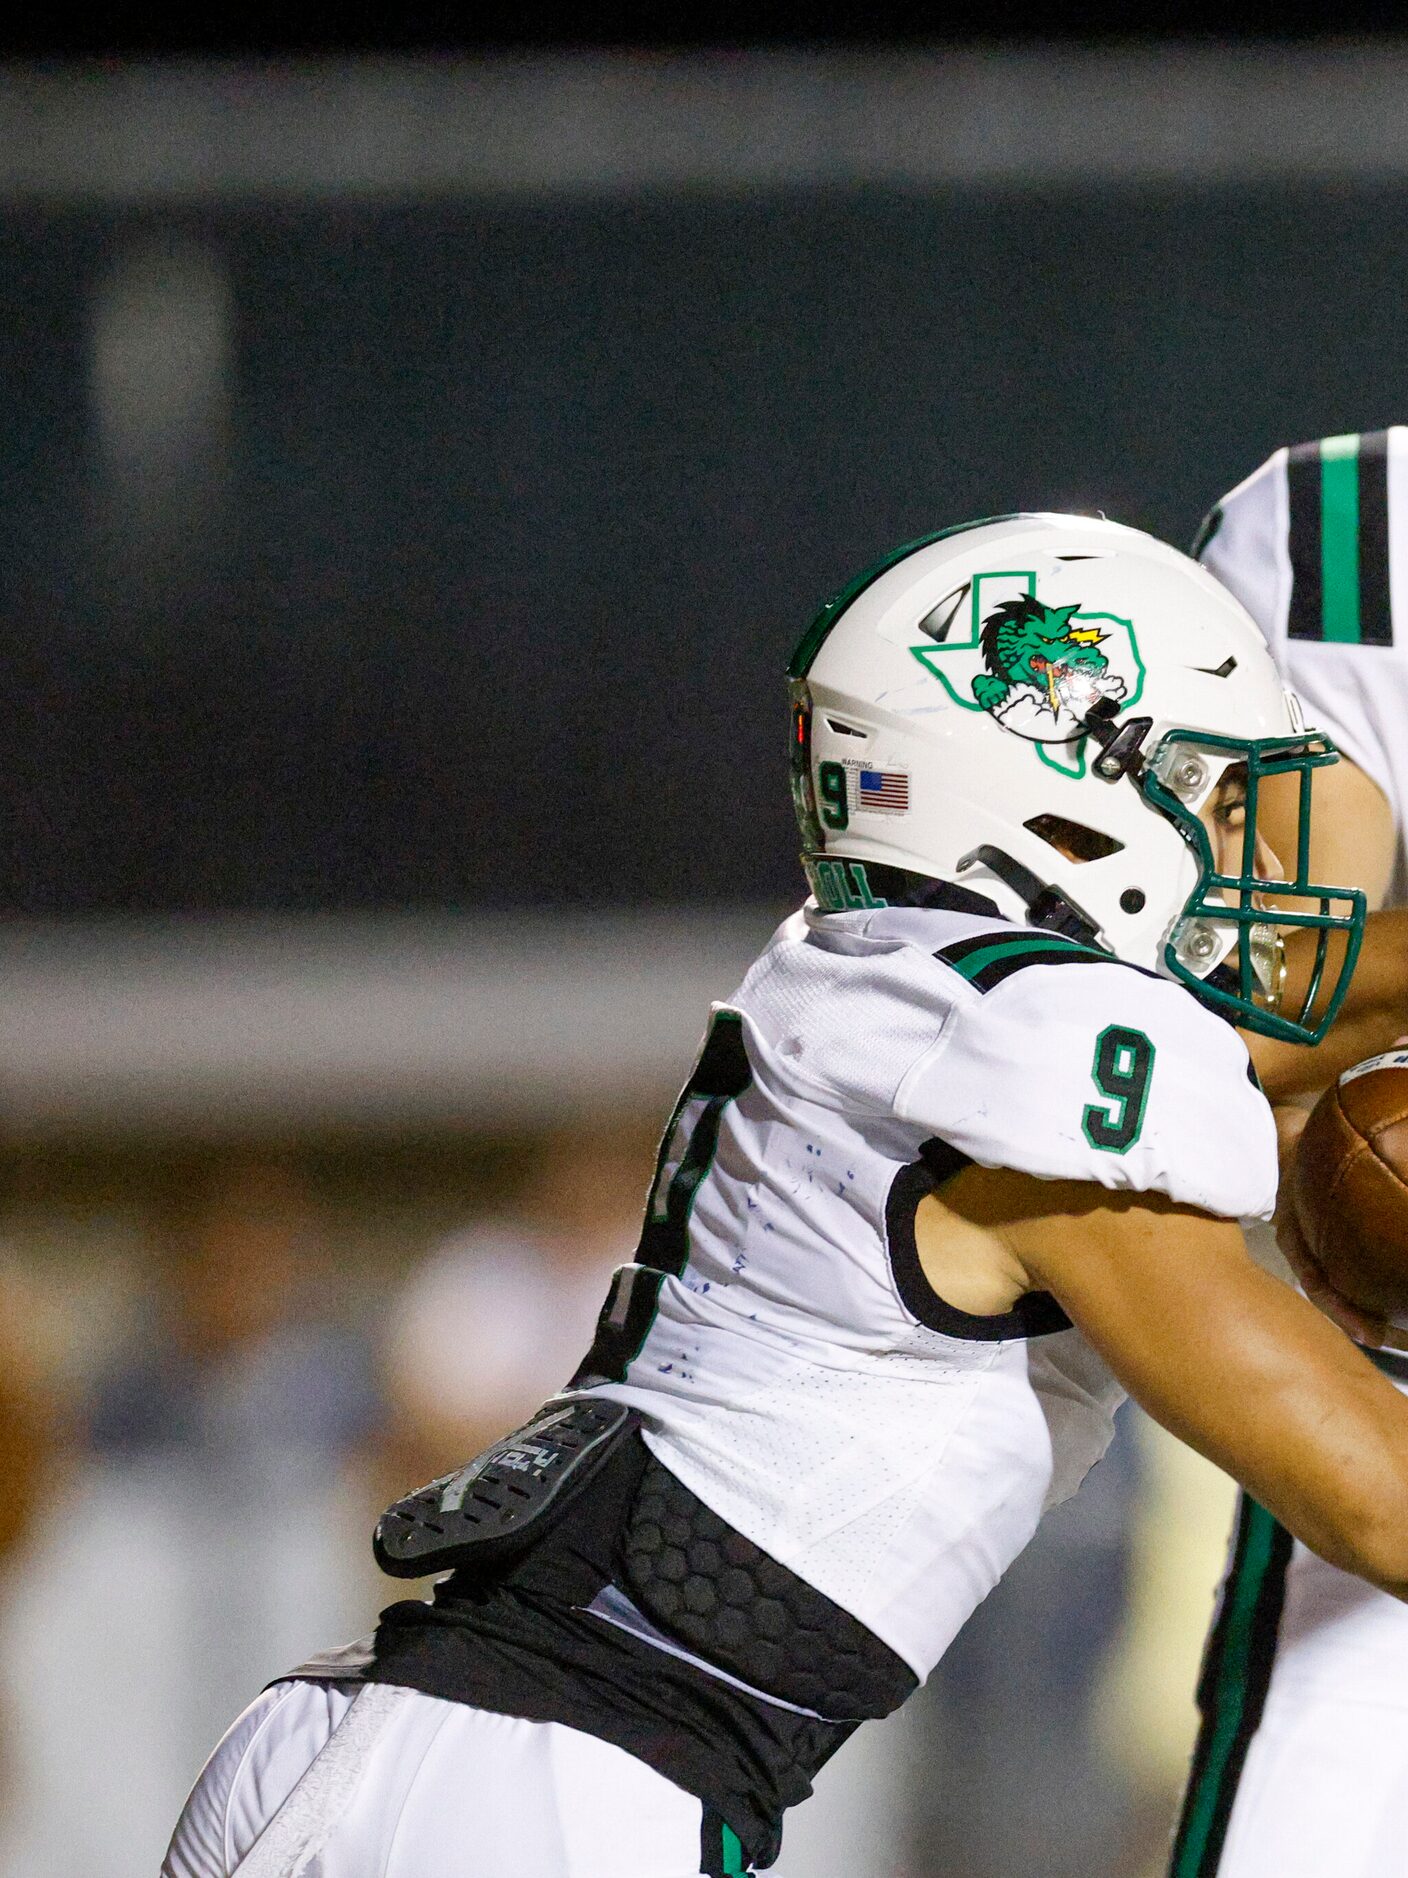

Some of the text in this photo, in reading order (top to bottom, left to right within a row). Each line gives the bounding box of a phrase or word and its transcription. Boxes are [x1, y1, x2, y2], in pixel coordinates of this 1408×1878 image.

[818, 760, 849, 831] 9
[841, 758, 873, 770] WARNING
[1081, 1023, 1157, 1156] 9
